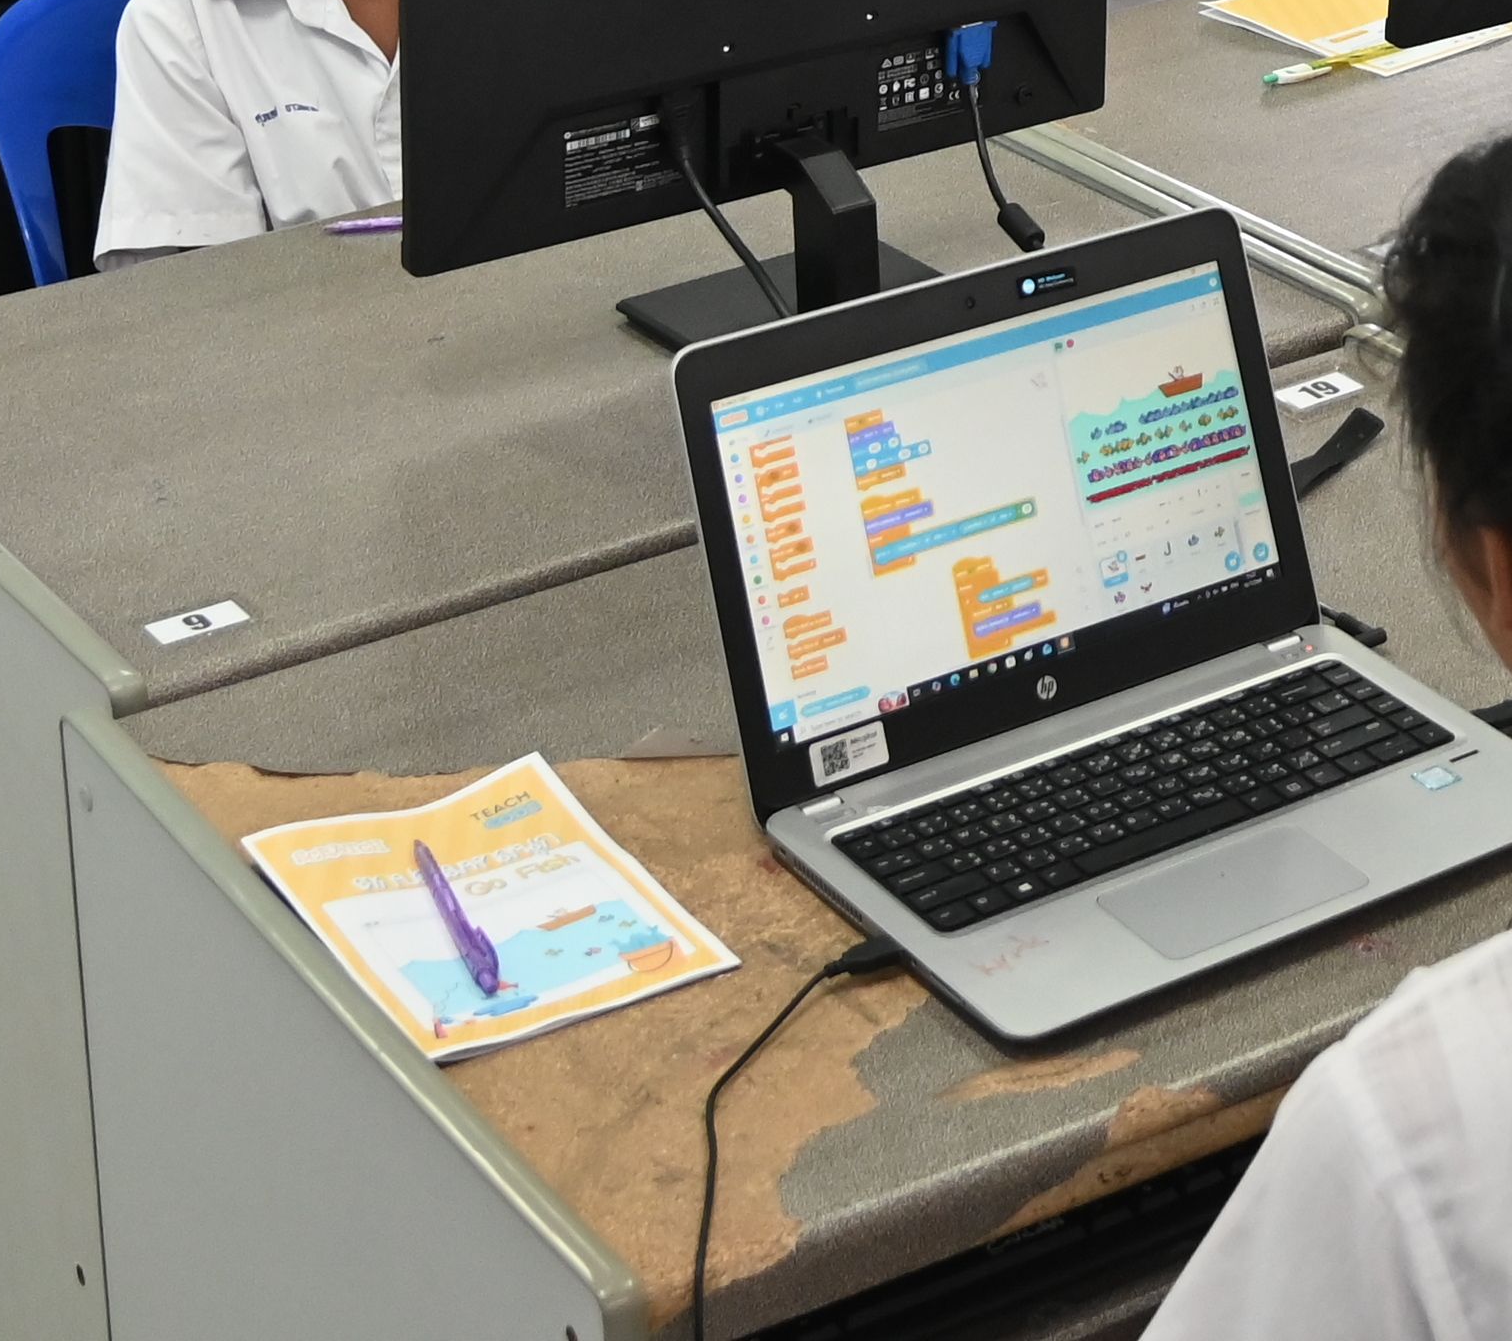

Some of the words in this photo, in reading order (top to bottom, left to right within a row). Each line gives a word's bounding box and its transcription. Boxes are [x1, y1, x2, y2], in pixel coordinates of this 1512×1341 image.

[1298, 380, 1340, 400] 19
[181, 615, 213, 631] 9
[1035, 674, 1058, 701] hp
[470, 791, 531, 823] TEACH
[515, 851, 582, 880] Fish
